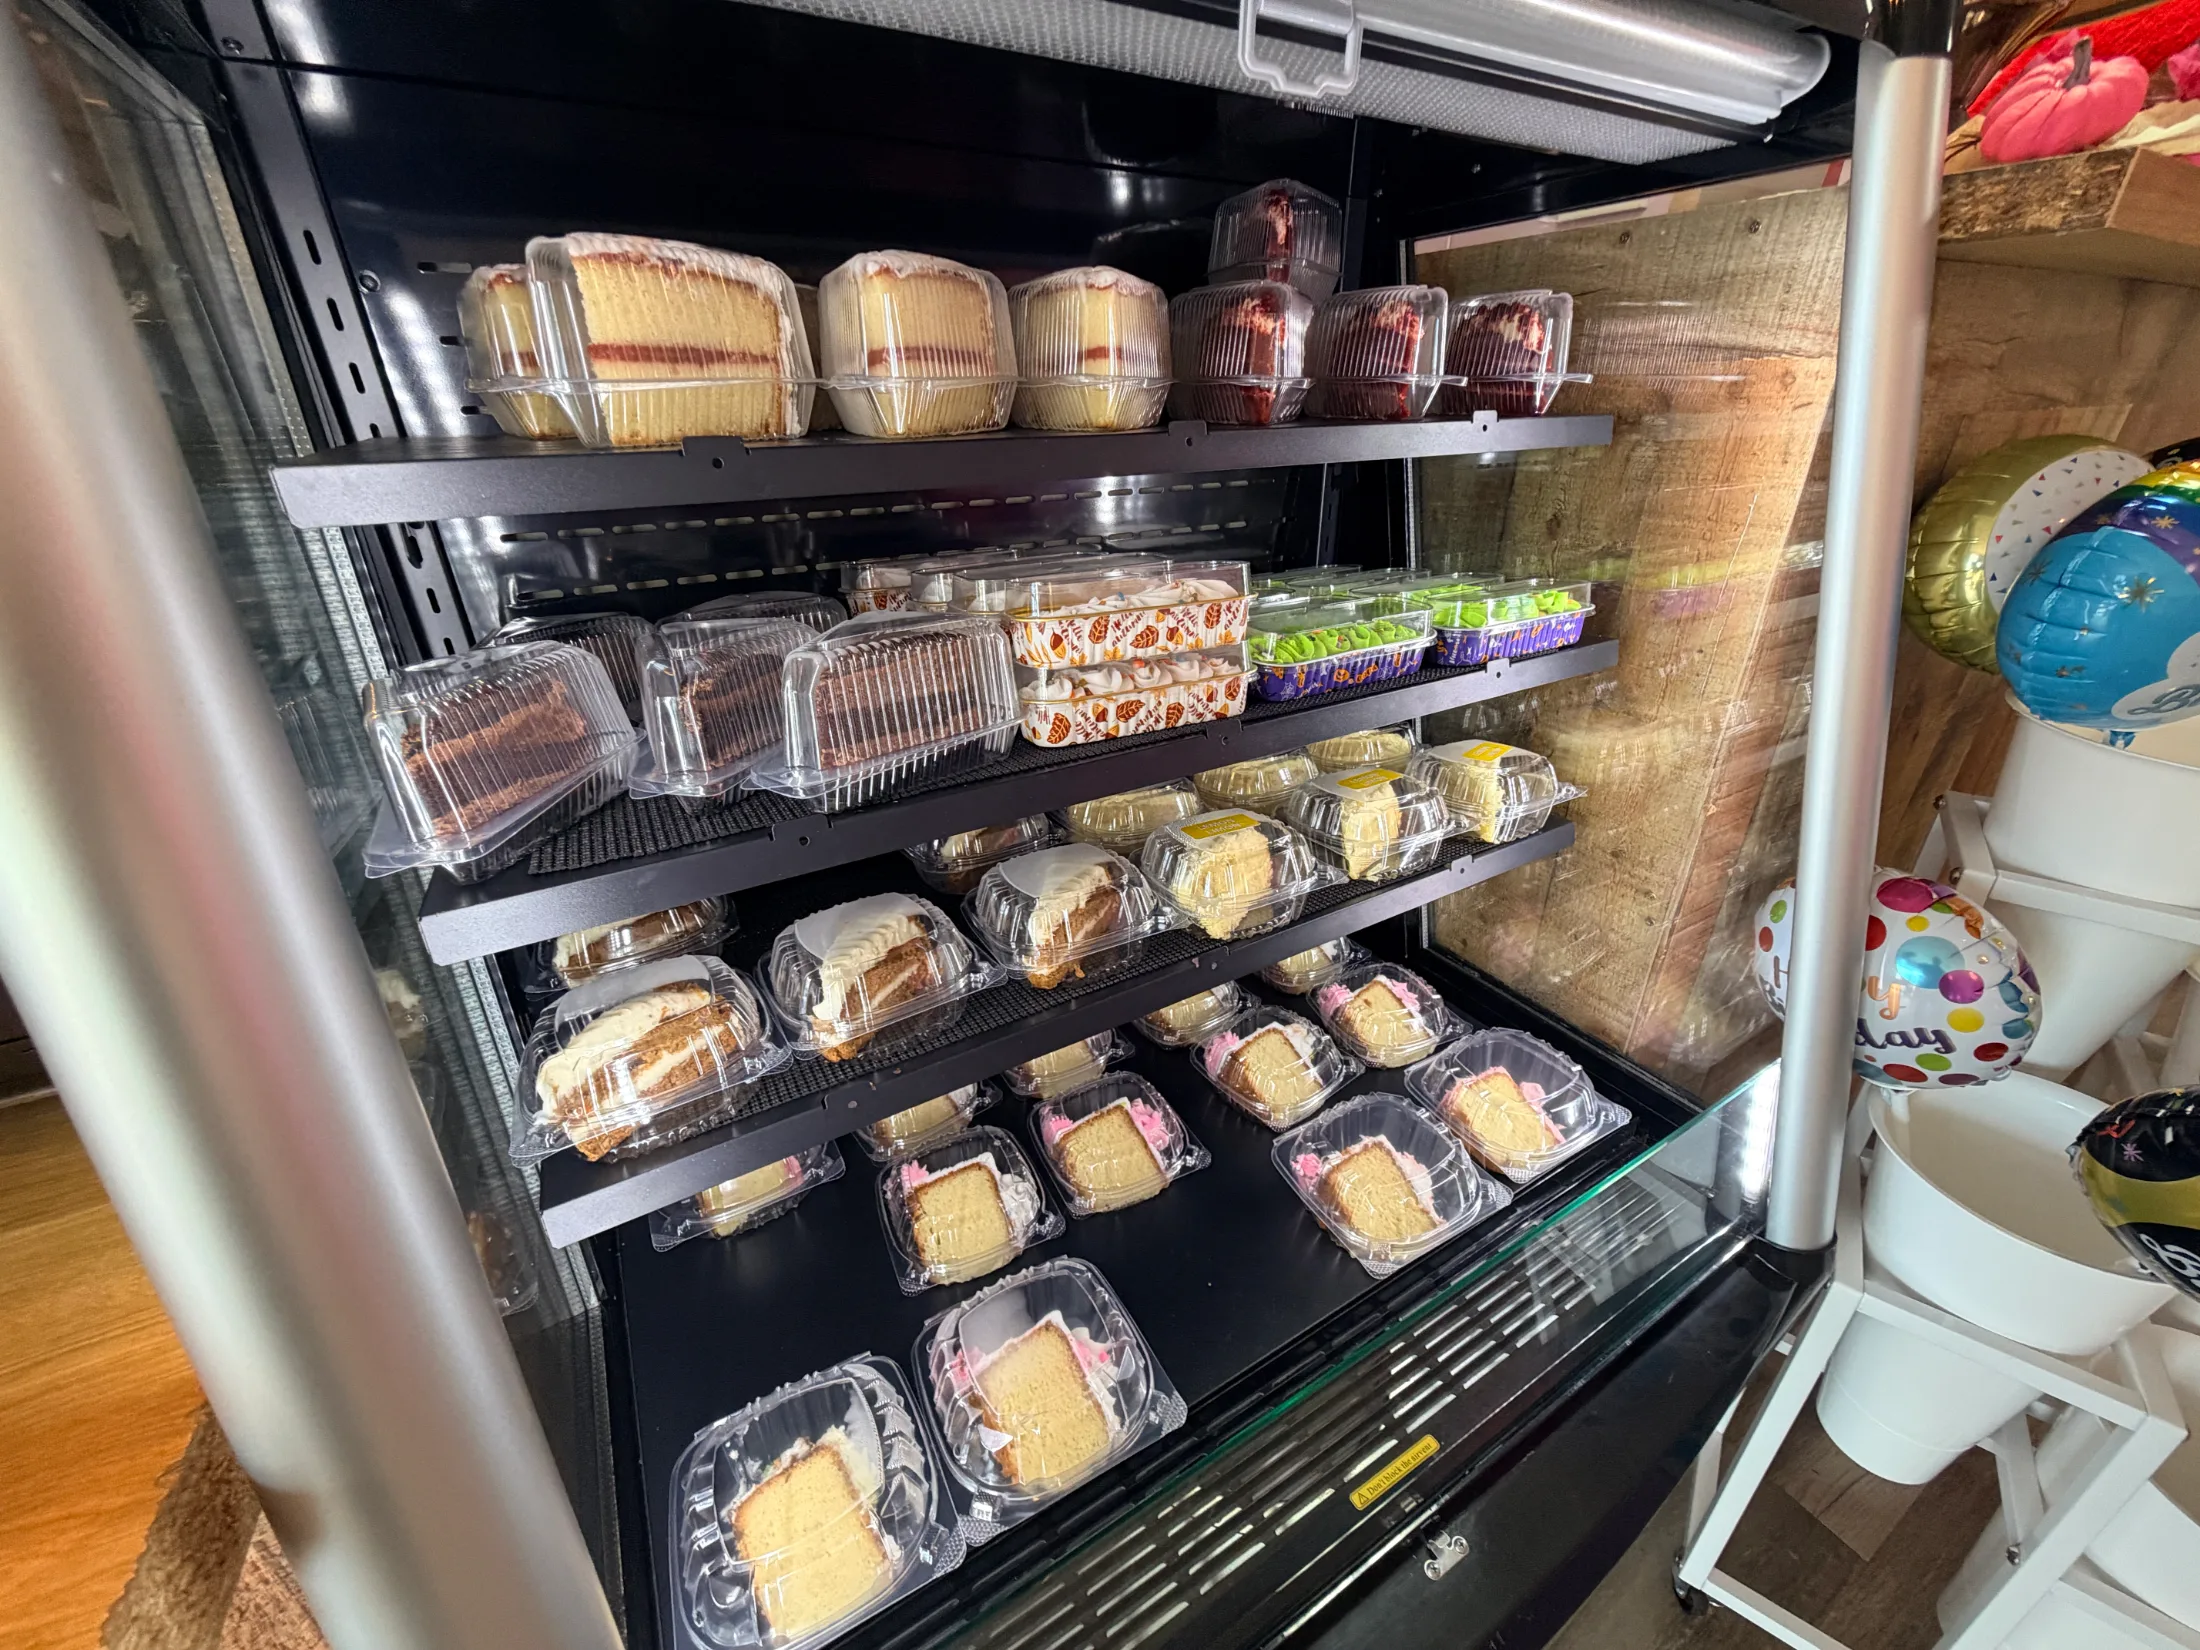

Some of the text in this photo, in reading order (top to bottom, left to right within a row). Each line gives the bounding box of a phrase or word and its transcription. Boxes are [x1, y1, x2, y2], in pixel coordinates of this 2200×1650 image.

[1366, 1443, 1433, 1496] Don't block the airvent
